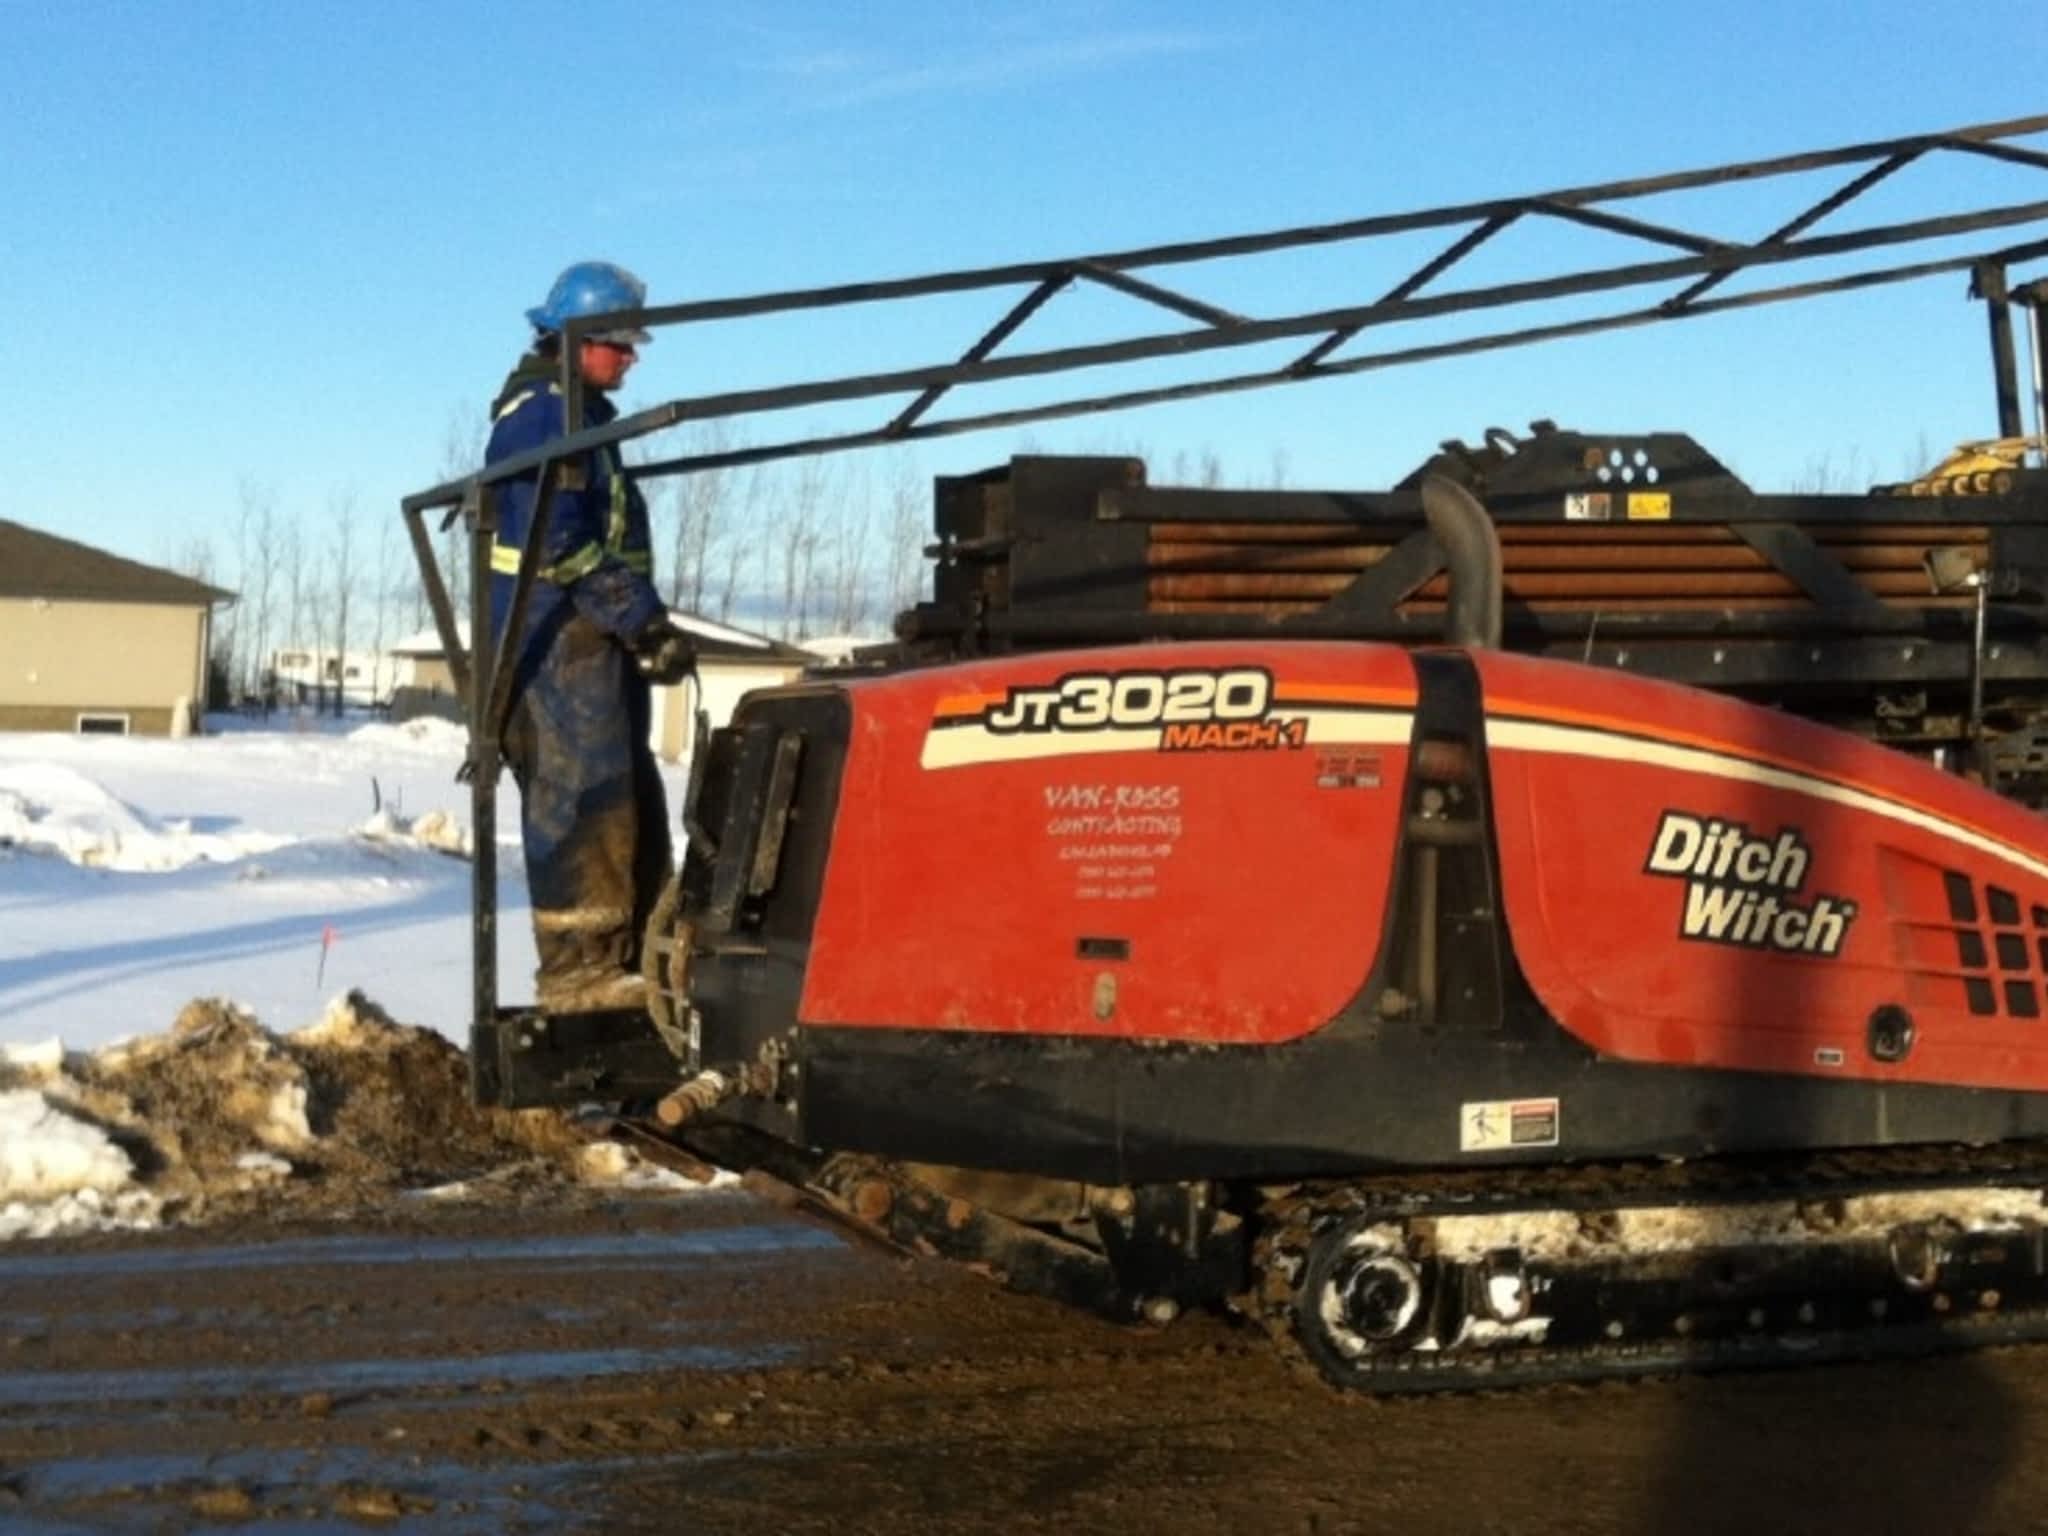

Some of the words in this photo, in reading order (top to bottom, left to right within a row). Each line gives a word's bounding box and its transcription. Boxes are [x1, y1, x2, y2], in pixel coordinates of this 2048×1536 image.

[989, 670, 1269, 728] JT3020
[1163, 721, 1279, 749] MACH
[1285, 719, 1306, 747] 1
[1649, 814, 1808, 889] Ditch
[1683, 882, 1846, 952] Witch
